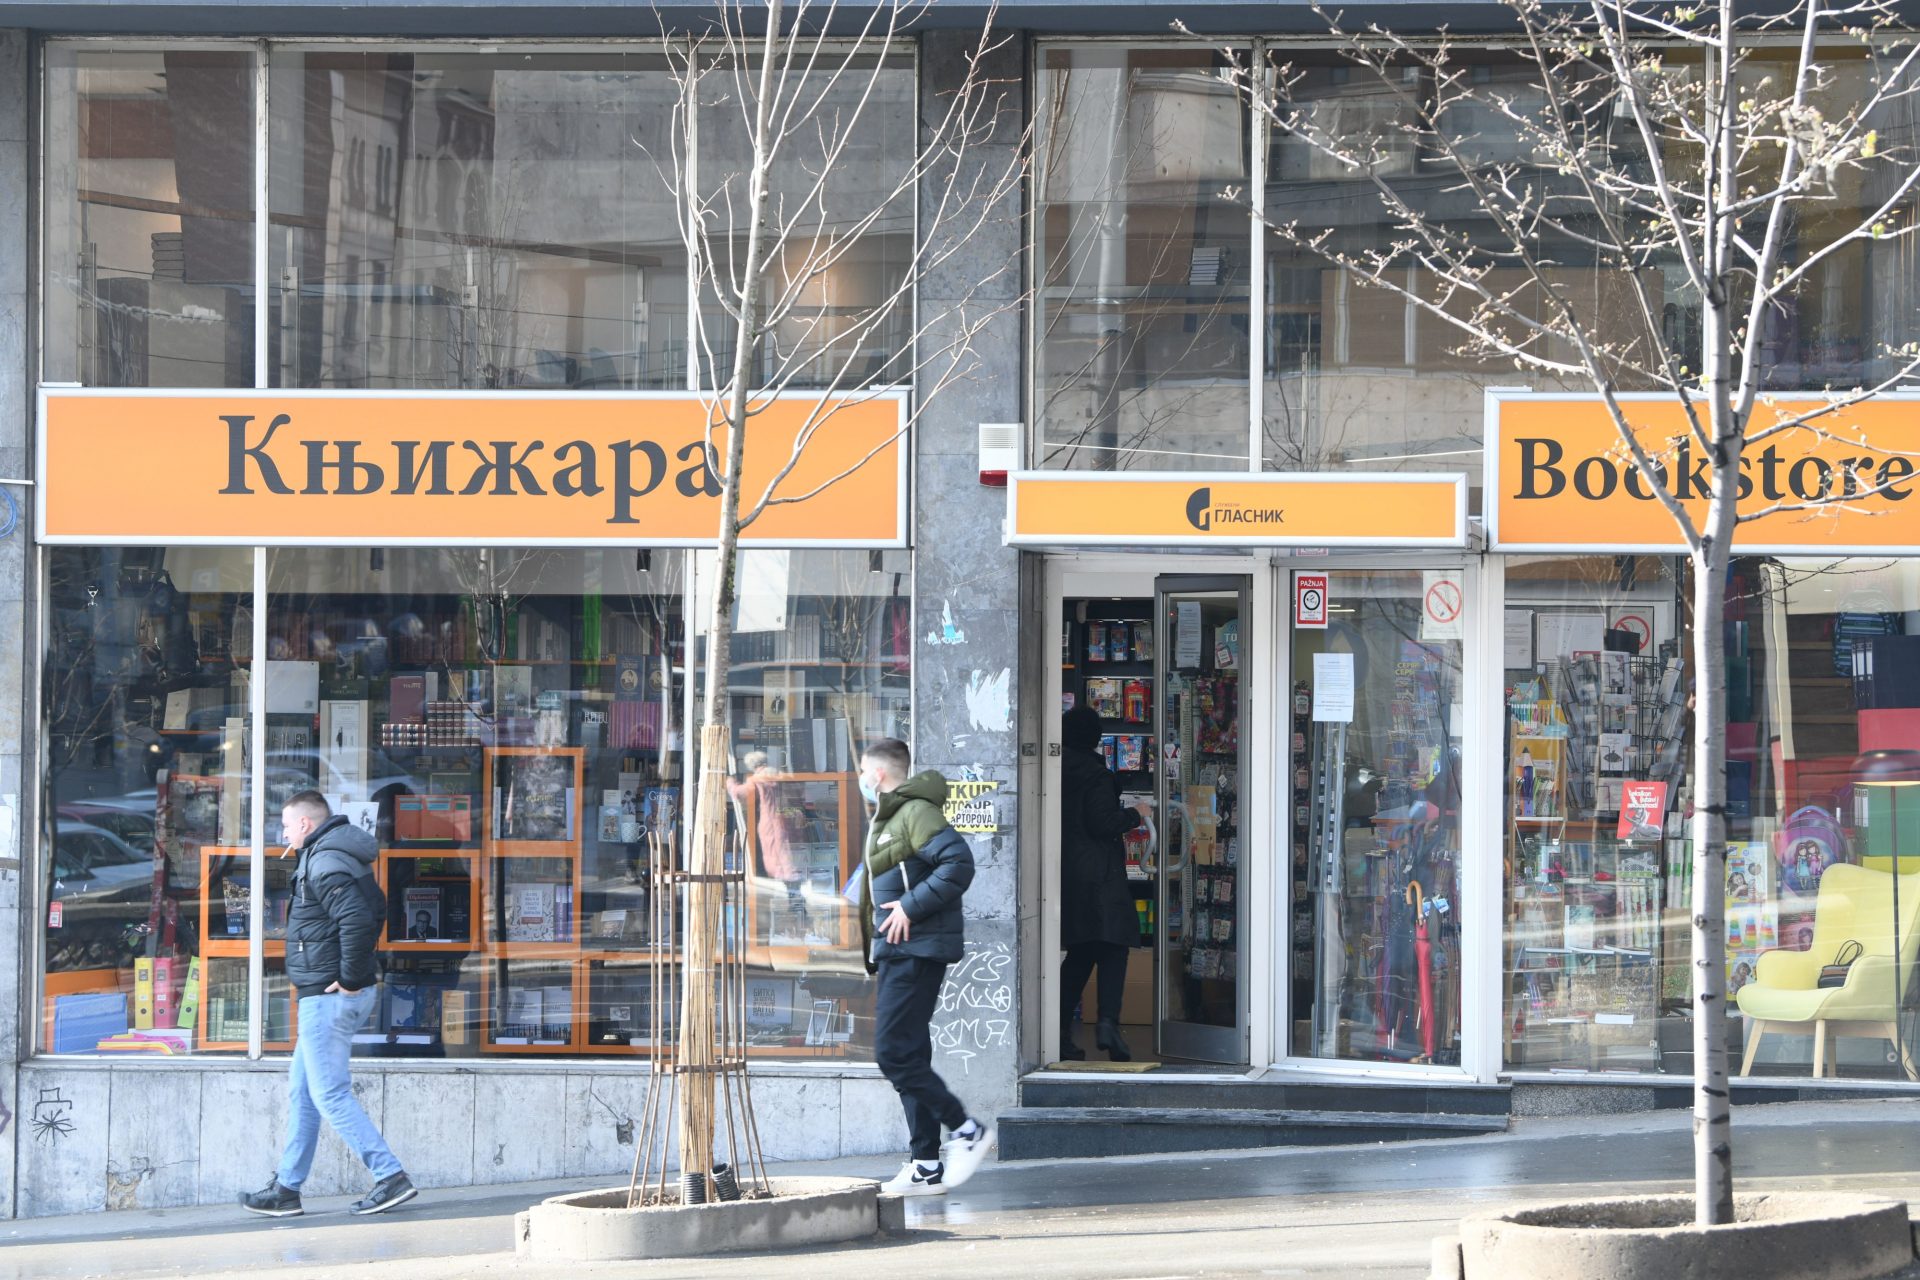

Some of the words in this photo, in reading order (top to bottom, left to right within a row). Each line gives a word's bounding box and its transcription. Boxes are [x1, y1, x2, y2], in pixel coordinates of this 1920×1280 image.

[218, 413, 725, 523] Књижара
[1513, 437, 1914, 500] Bookstore
[1214, 509, 1284, 523] ГЛАСНИК
[753, 988, 775, 997] БИТКА
